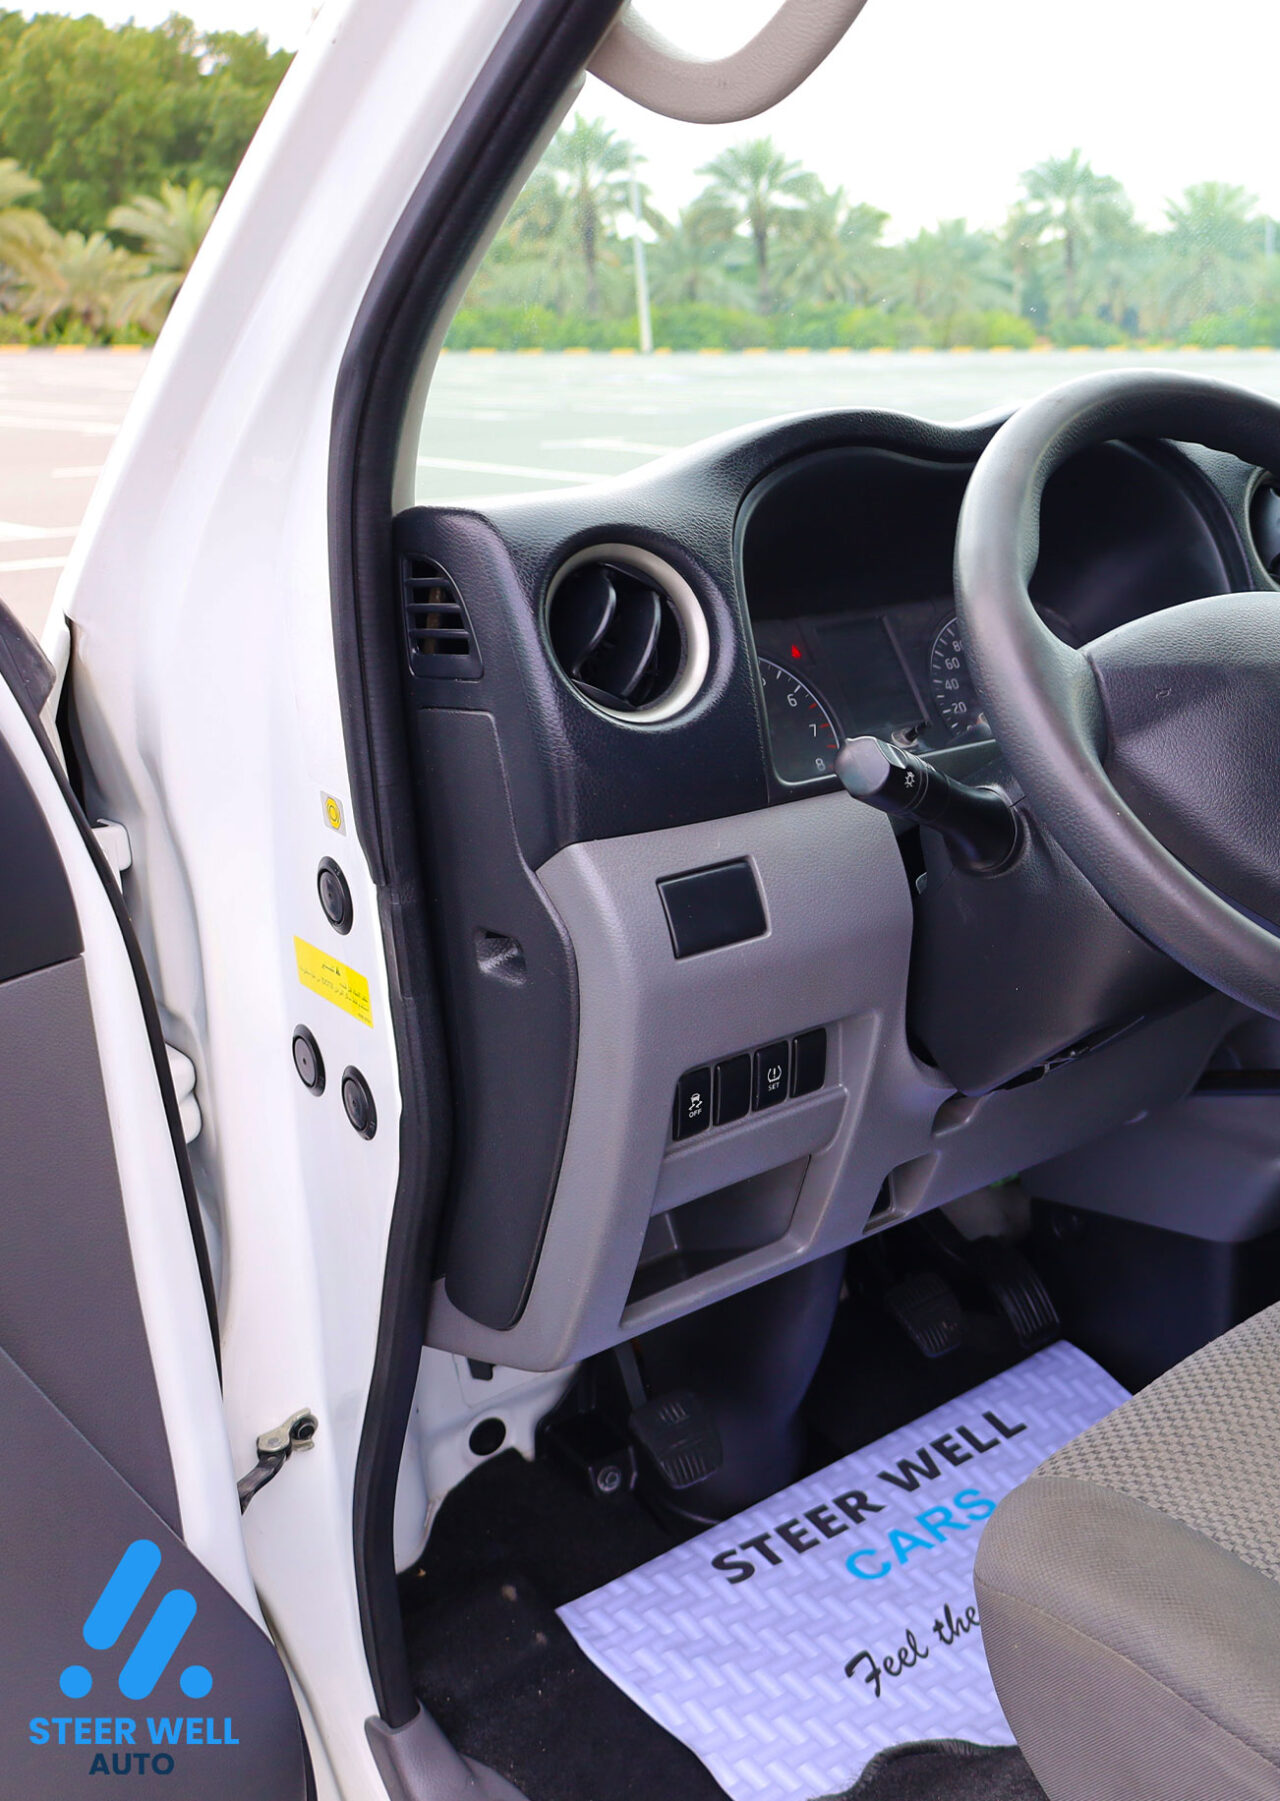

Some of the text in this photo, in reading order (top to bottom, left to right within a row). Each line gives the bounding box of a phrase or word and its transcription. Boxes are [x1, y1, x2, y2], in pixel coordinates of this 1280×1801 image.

[945, 657, 960, 670] 60
[945, 678, 959, 690] 40
[786, 693, 798, 707] 6
[952, 701, 967, 714] 20
[808, 723, 817, 737] 7
[815, 757, 826, 772] 8
[767, 1082, 780, 1092] SET
[688, 1109, 702, 1118] OFF
[711, 1411, 1028, 1585] STEER WELL
[845, 1488, 997, 1580] CARS
[844, 1603, 981, 1698] Feel the
